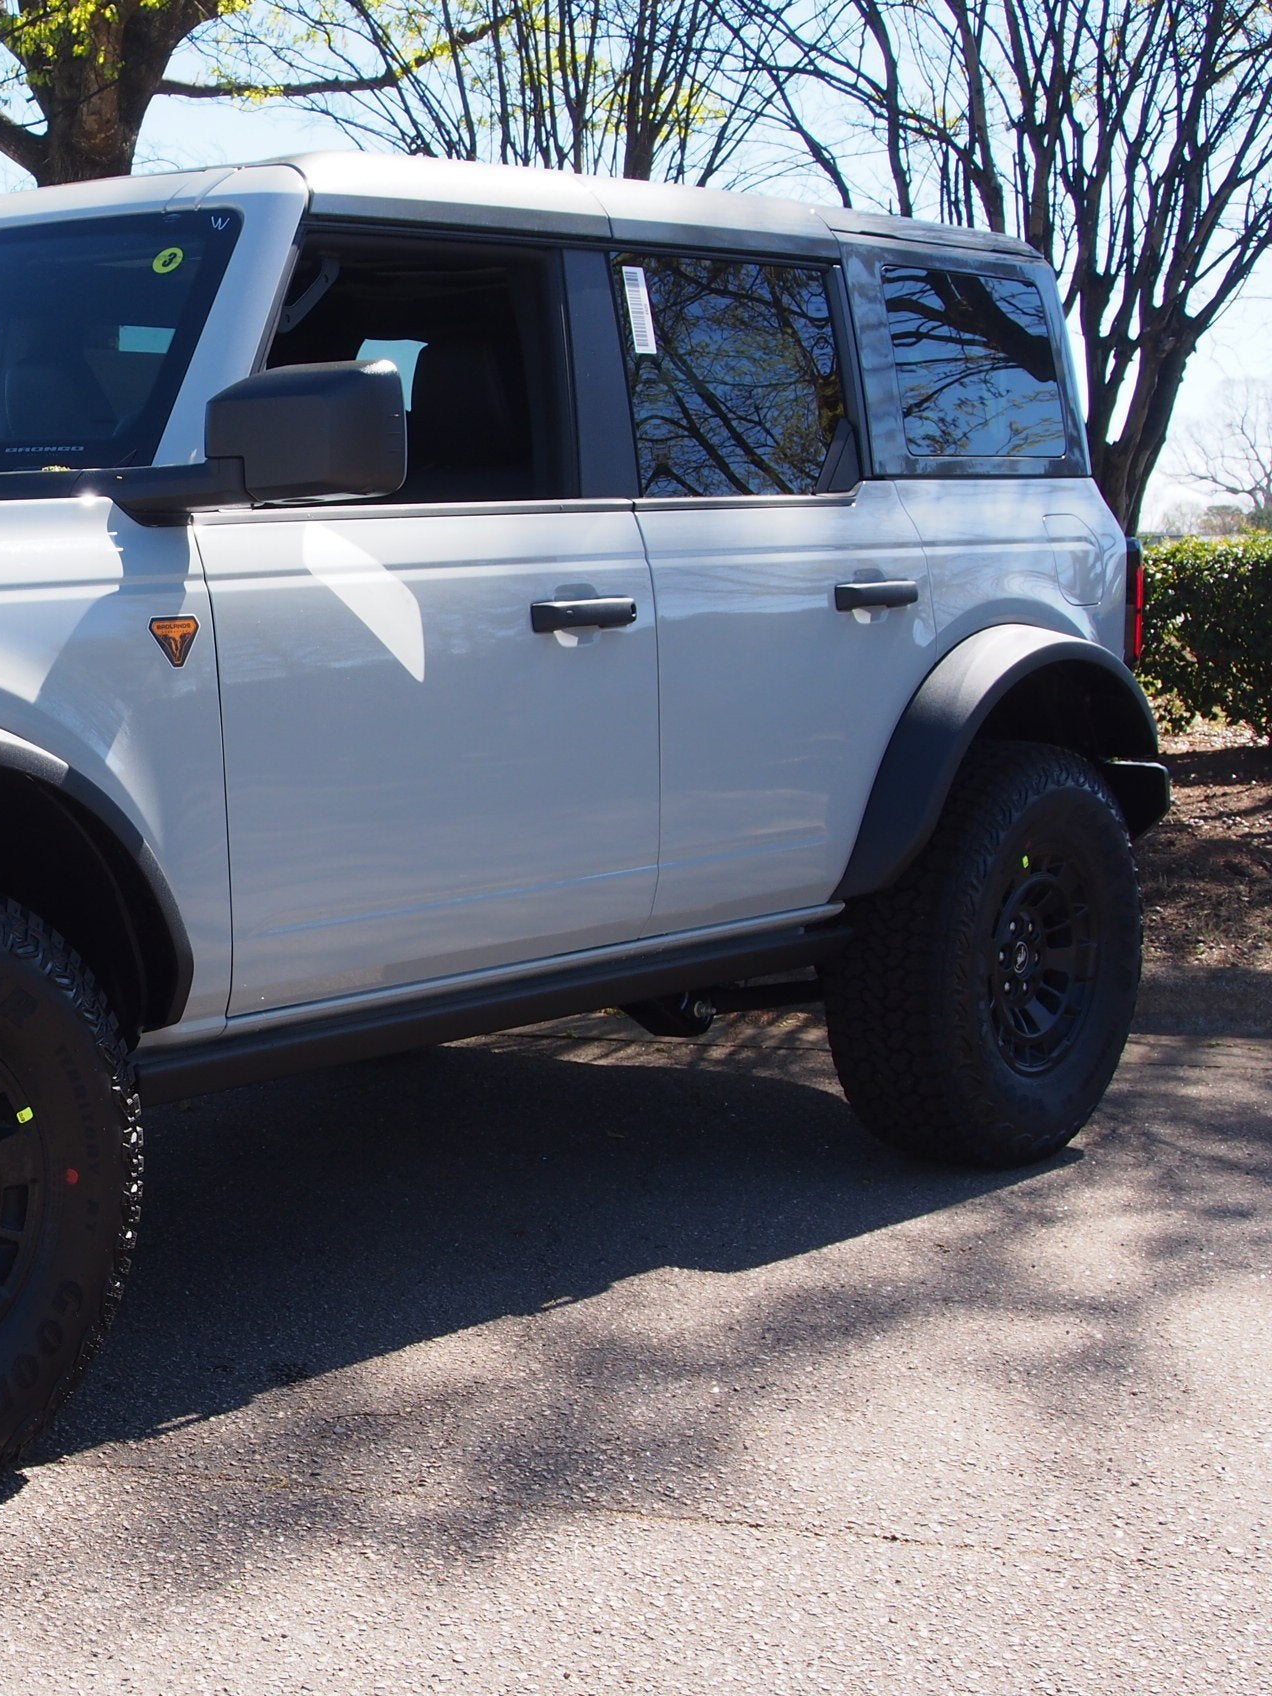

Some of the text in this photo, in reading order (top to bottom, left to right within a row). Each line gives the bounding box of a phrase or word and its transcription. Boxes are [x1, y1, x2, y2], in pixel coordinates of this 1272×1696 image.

[210, 215, 231, 230] W
[161, 251, 178, 268] 3
[5, 445, 85, 454] BRONCO
[156, 622, 191, 630] BADLANDS
